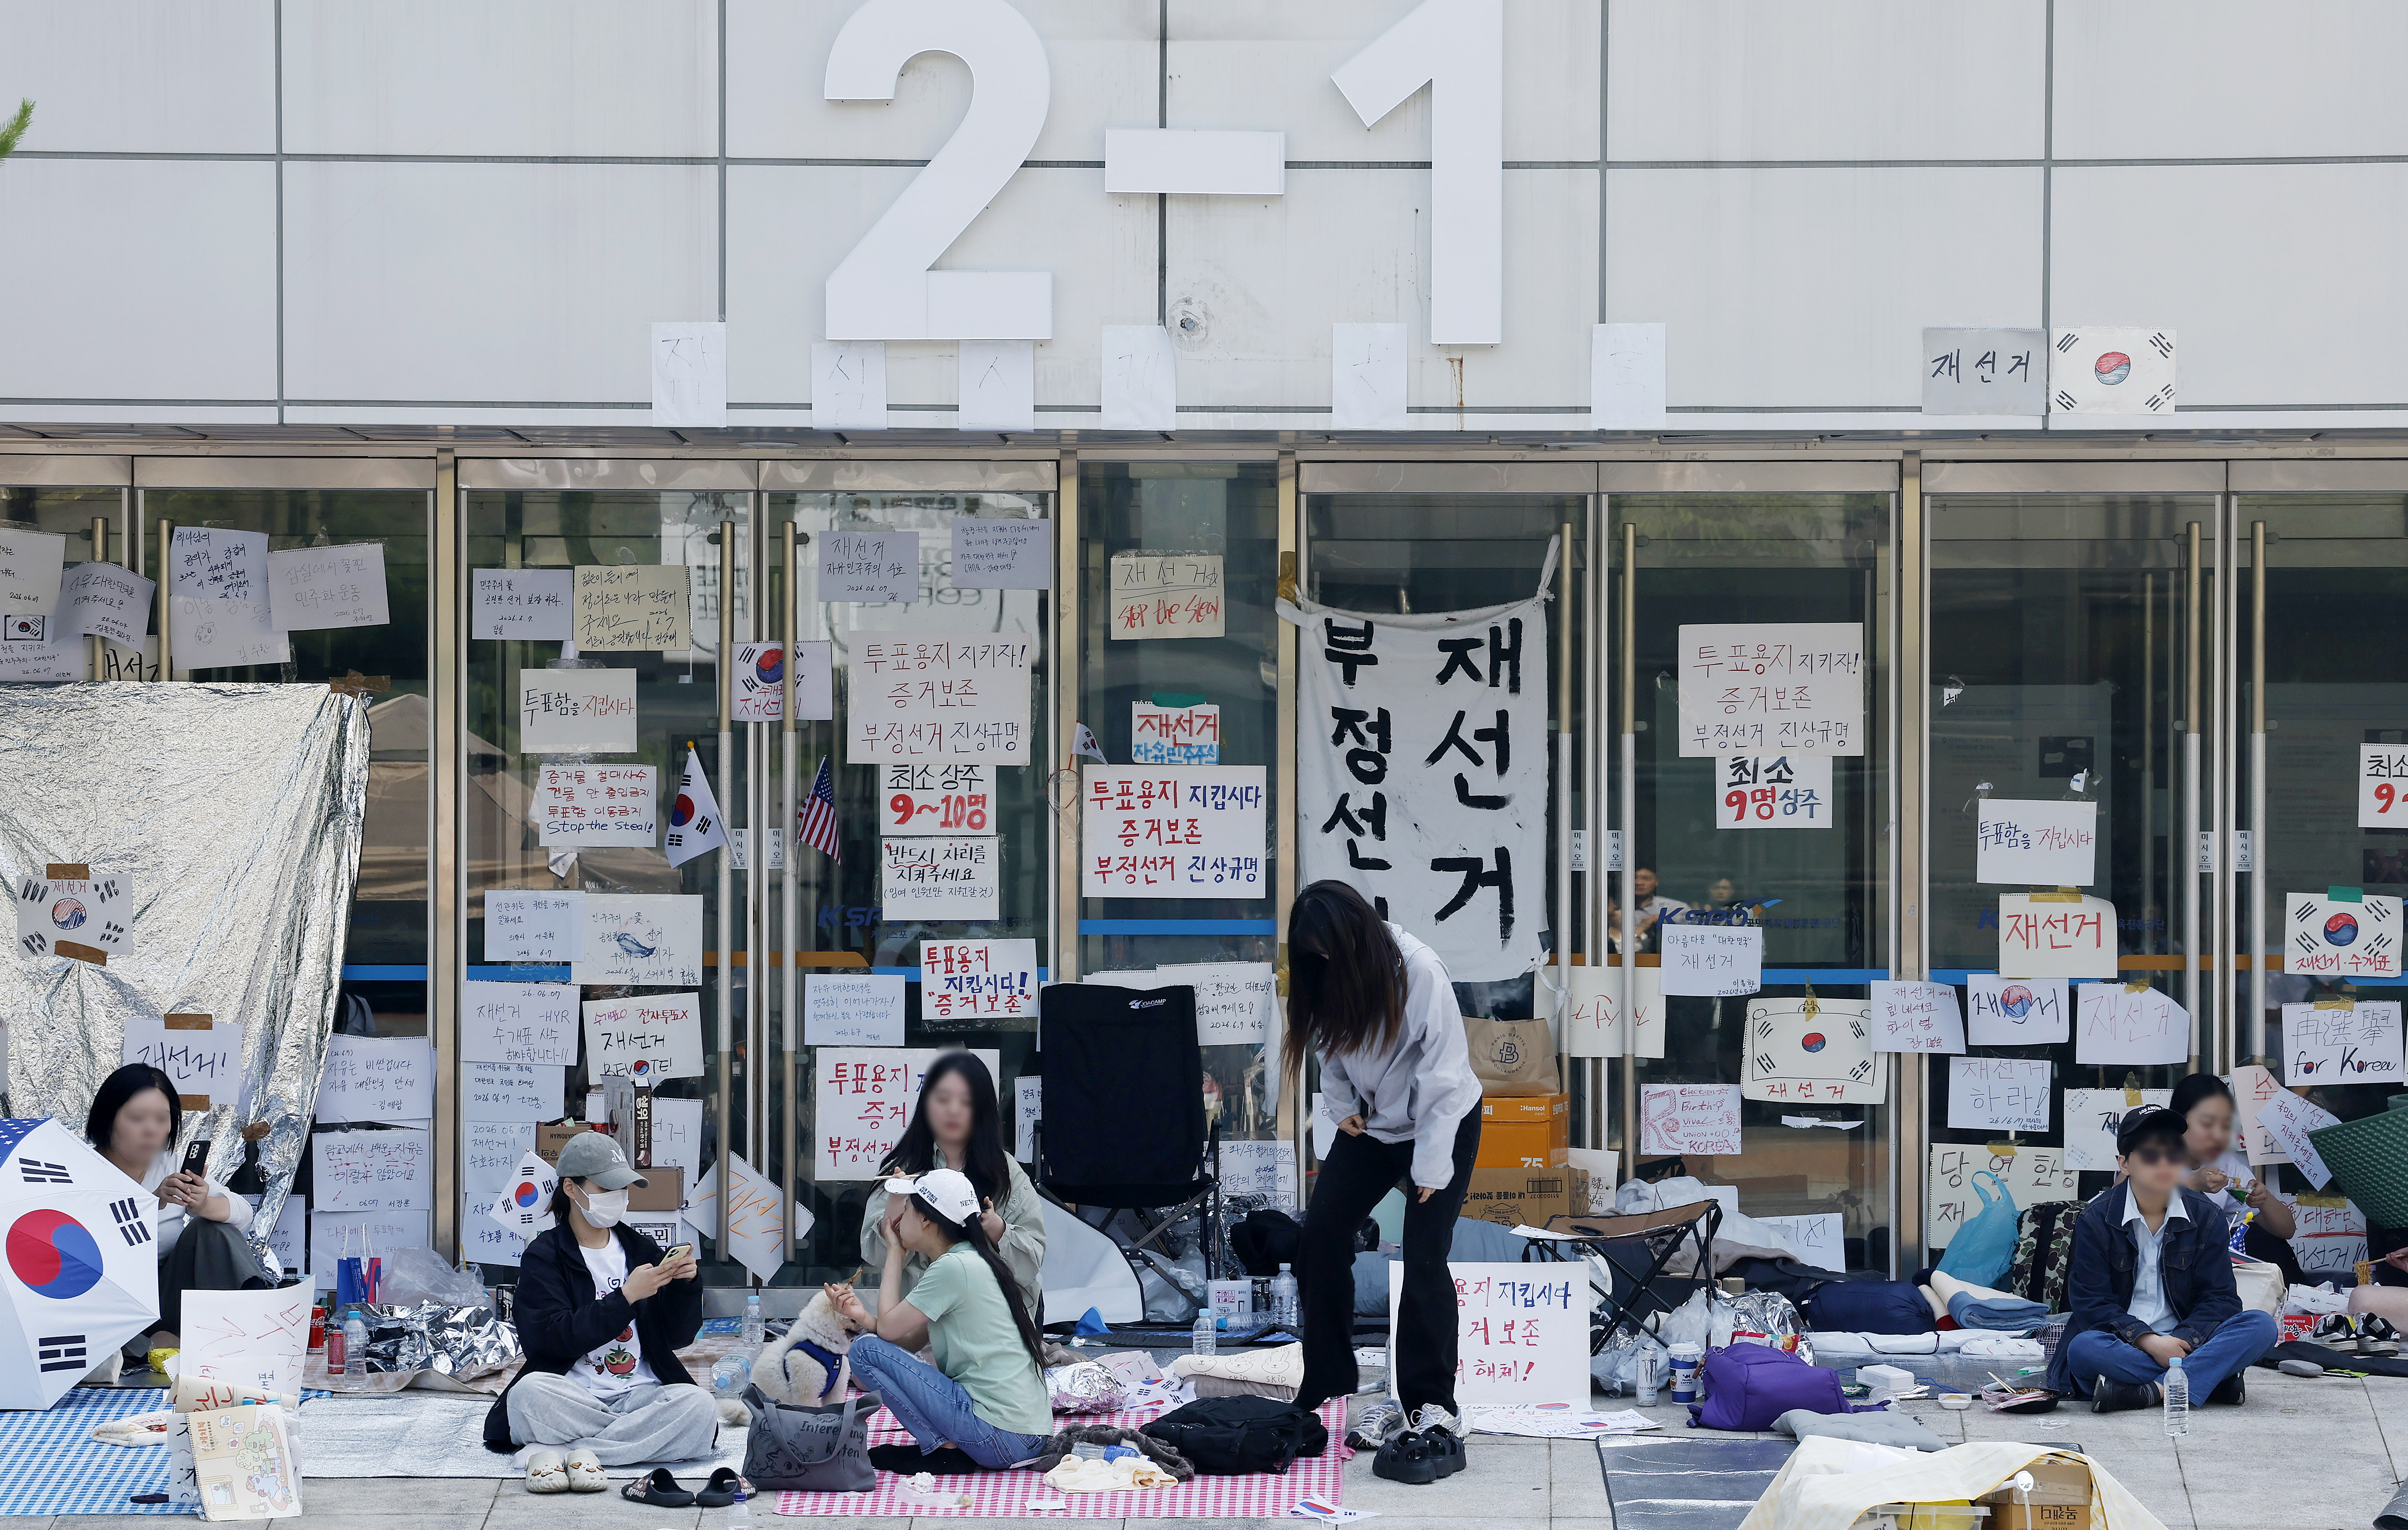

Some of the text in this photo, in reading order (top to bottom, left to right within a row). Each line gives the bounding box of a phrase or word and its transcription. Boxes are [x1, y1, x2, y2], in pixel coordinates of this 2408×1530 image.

[1931, 349, 2030, 383] 재선거
[177, 531, 210, 546] 하나님의
[832, 538, 885, 561] 재선거
[286, 561, 338, 585] 잠실에서
[827, 562, 880, 578] 자유민주주의
[1121, 561, 1207, 586] 재선거
[295, 584, 361, 609] 민주화 운동
[1154, 599, 1181, 624] the
[864, 643, 1026, 673] 투표용지 지키자!
[1693, 644, 1859, 678] 투표용지 지키자!
[888, 679, 978, 709] 증거보존
[1717, 686, 1811, 714] 증거보존
[524, 688, 580, 726] 투표함을
[861, 722, 1019, 755] 부정선거 진상규명
[1138, 710, 1217, 747] 재선거
[1693, 720, 1848, 749] 부정선거 진상규명
[546, 769, 647, 784] 증거물 절대사수
[887, 765, 984, 791] 최소 상주
[1321, 617, 1392, 921] 부정선
[1727, 756, 1794, 788] 최소
[605, 786, 650, 800] 출입금지
[1090, 780, 1262, 810] 투표용지 지킵시다
[1422, 617, 1523, 950] 재선거
[548, 806, 642, 818] 투표함 이동금지
[890, 794, 987, 830] 9~10명
[1118, 818, 1202, 847] 증거보존
[1979, 821, 2094, 851] 투표함을 지킵시다
[889, 845, 986, 864] 반드시 자리를
[896, 867, 975, 883] 지켜주세요
[1094, 856, 1258, 885] 부정선거 진상규명
[51, 880, 87, 895] 재선거
[911, 887, 942, 898] 인원만
[496, 900, 525, 911] 선관위는
[498, 915, 524, 925] 일하세요
[2006, 912, 2101, 950] 재선거
[1668, 935, 1705, 948] 아름다운
[925, 946, 989, 974] 투표용지
[1681, 953, 1732, 969] 재선거
[522, 989, 560, 999] 26.06.07
[813, 983, 871, 994] 자유 대한민국을
[944, 971, 1029, 996] 지킵시다!
[1893, 986, 1935, 1000] 재선거
[477, 1003, 520, 1023] 재선거
[813, 996, 895, 1008] 영원히 이어나가자!
[855, 1010, 890, 1020] 사랑합니다
[2084, 995, 2170, 1042] 재선거
[493, 1026, 559, 1046] 수개표 사수
[602, 1031, 665, 1051] 재선거
[328, 1060, 357, 1076] 자유는
[1961, 1060, 2044, 1080] 재선거
[2294, 1046, 2397, 1078] for Korea
[328, 1079, 347, 1092] 자유
[355, 1077, 385, 1091] 대한민국
[828, 1063, 908, 1095] 투표용지
[1766, 1082, 1845, 1100] 재선거
[1970, 1085, 2049, 1115] 하라!
[1689, 1140, 1735, 1153] KOREA
[469, 1154, 514, 1170] 수호하자
[1498, 1281, 1572, 1309] 지킵시다
[1473, 1359, 1535, 1384] 해체!
